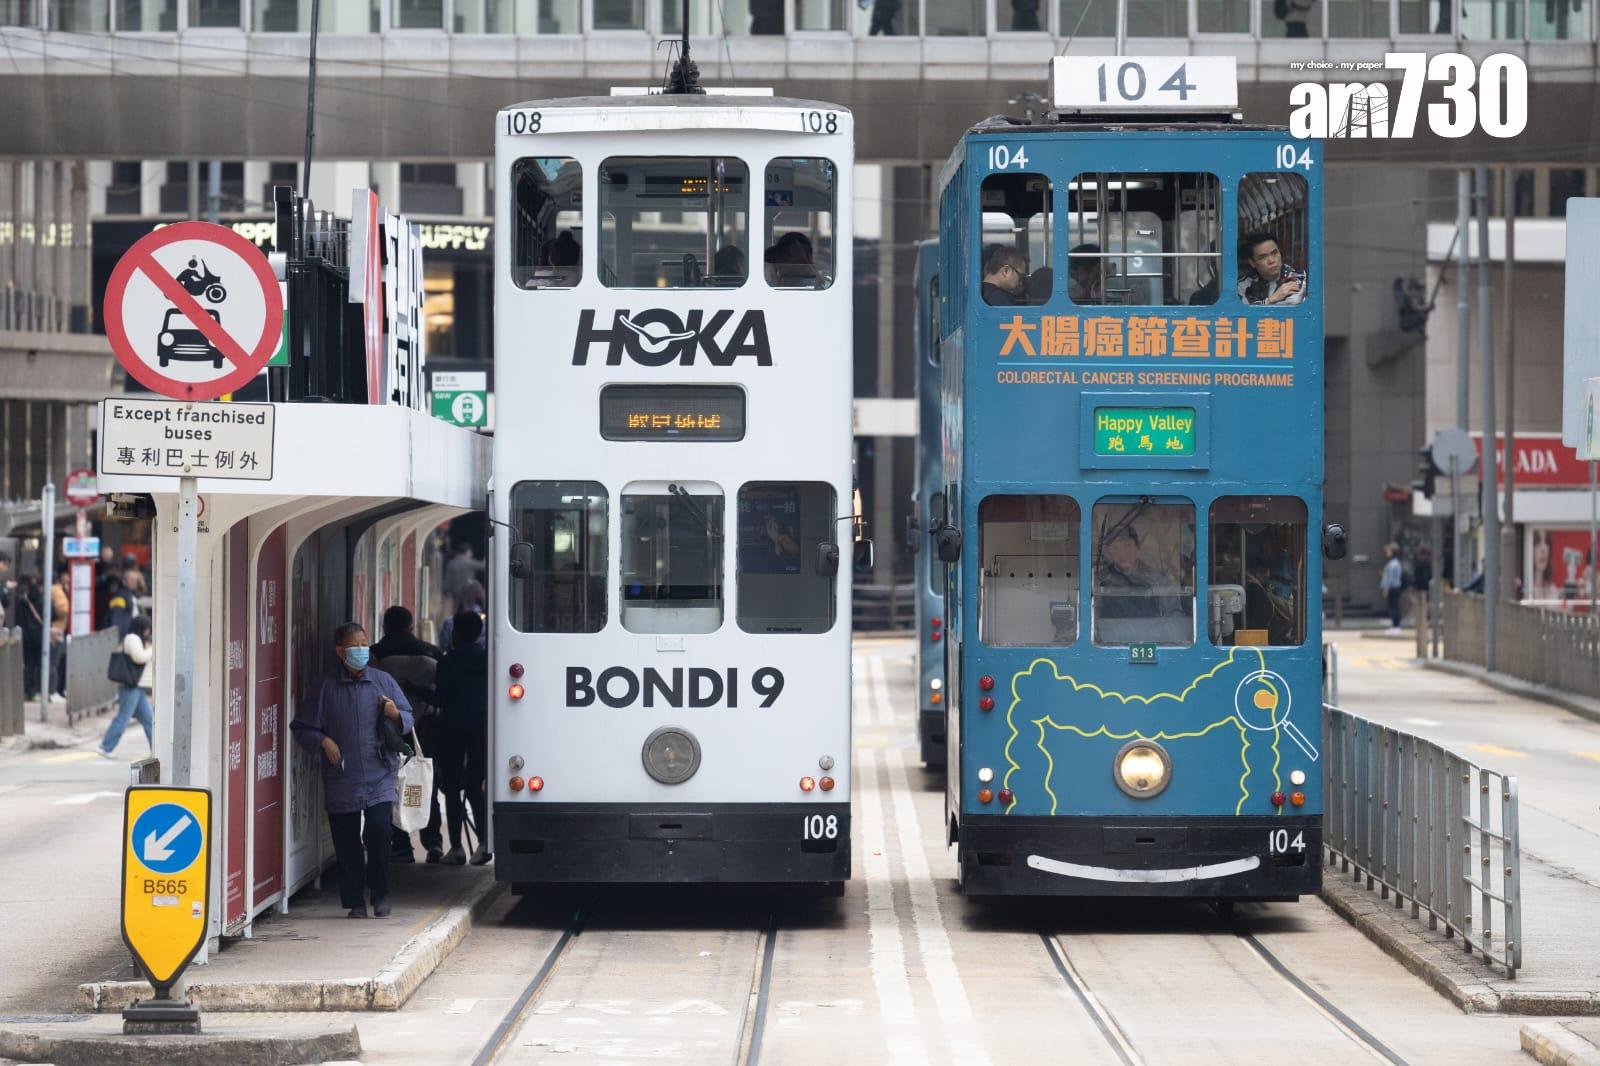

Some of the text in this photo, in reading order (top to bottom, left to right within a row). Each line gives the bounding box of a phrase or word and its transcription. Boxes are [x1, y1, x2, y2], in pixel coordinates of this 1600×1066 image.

[1097, 61, 1197, 102] 104
[507, 111, 542, 135] 108
[800, 111, 838, 135] 108
[988, 144, 1029, 170] 104
[1276, 144, 1314, 170] 104
[571, 308, 773, 367] HOKA
[998, 314, 1295, 359] 大腸癌篩查計劃
[996, 370, 1295, 387] COLORECTAL CANCER SCREENING PROGRAMME
[113, 405, 266, 425] Except franchised
[1097, 415, 1193, 432] Happy Valley
[164, 426, 212, 441] buses
[1107, 435, 1184, 452] 跑馬地
[116, 446, 259, 471] 專利巴士例外
[1131, 646, 1155, 660] S13
[565, 665, 785, 709] BONDI 9
[803, 814, 838, 840] 108
[1269, 828, 1306, 854] 104
[143, 879, 187, 895] B565
